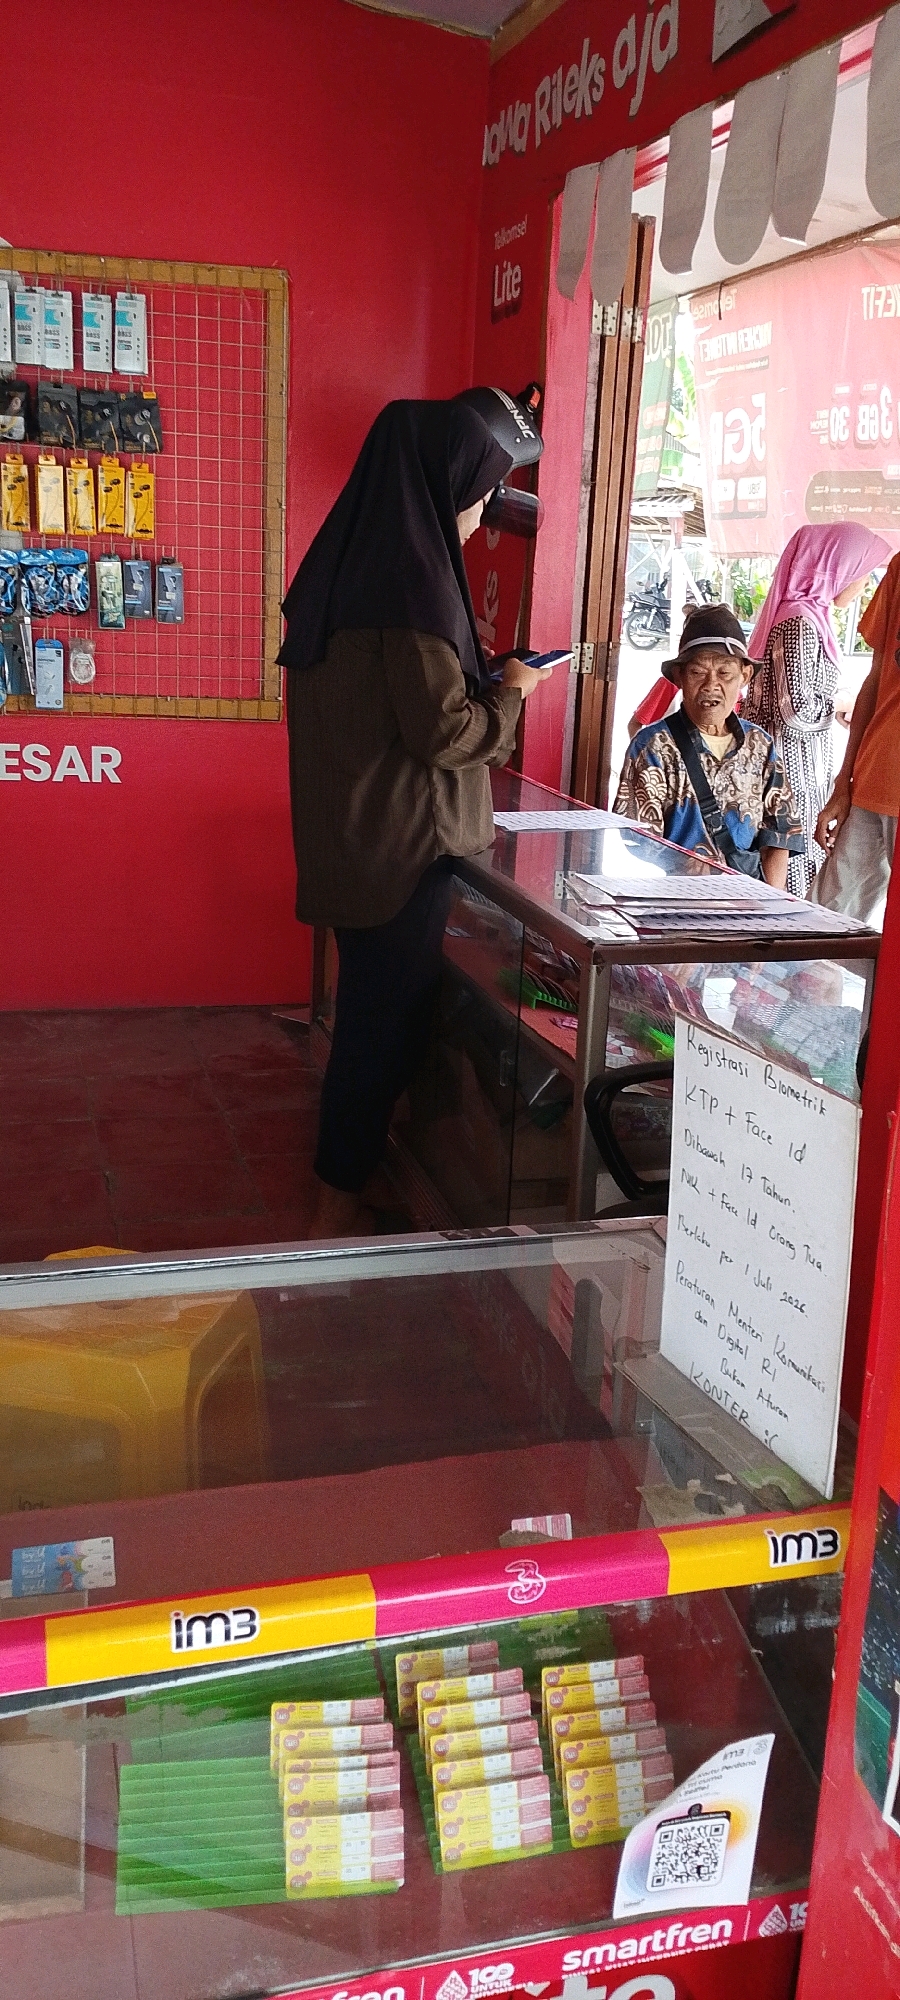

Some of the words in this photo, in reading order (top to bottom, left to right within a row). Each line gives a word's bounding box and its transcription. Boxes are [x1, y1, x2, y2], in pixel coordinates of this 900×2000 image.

[482, 100, 532, 166] awa
[535, 37, 606, 149] Rileks
[612, 0, 680, 117] aja
[494, 213, 528, 250] Telkomsel
[493, 260, 522, 307] Lite
[687, 1024, 749, 1078] Registrasi
[685, 1077, 719, 1114] KTP
[725, 1106, 737, 1125] +
[745, 1111, 773, 1145] Face
[684, 1128, 726, 1167] Dibawah
[741, 1163, 754, 1184] 17
[680, 1167, 700, 1195] NIK
[708, 1188, 717, 1202] +
[768, 1224, 796, 1260] Orang
[677, 1213, 711, 1248] Berlaku
[753, 1269, 773, 1292] Juli
[675, 1259, 716, 1310] Peraturan
[727, 1300, 764, 1343] Menteri
[773, 1333, 826, 1394] Komunikasi
[694, 1309, 709, 1328] dan
[717, 1323, 749, 1361] Digital
[761, 1357, 777, 1383] RI
[688, 1361, 751, 1428] KONTER
[720, 1357, 747, 1390] Bukan
[756, 1387, 790, 1423] Aturan
[767, 1528, 841, 1566] im3
[171, 1607, 259, 1652] im3
[561, 1918, 734, 1972] smartfren
[468, 1962, 515, 1988] 100
[471, 1979, 513, 1994] UNTUK
